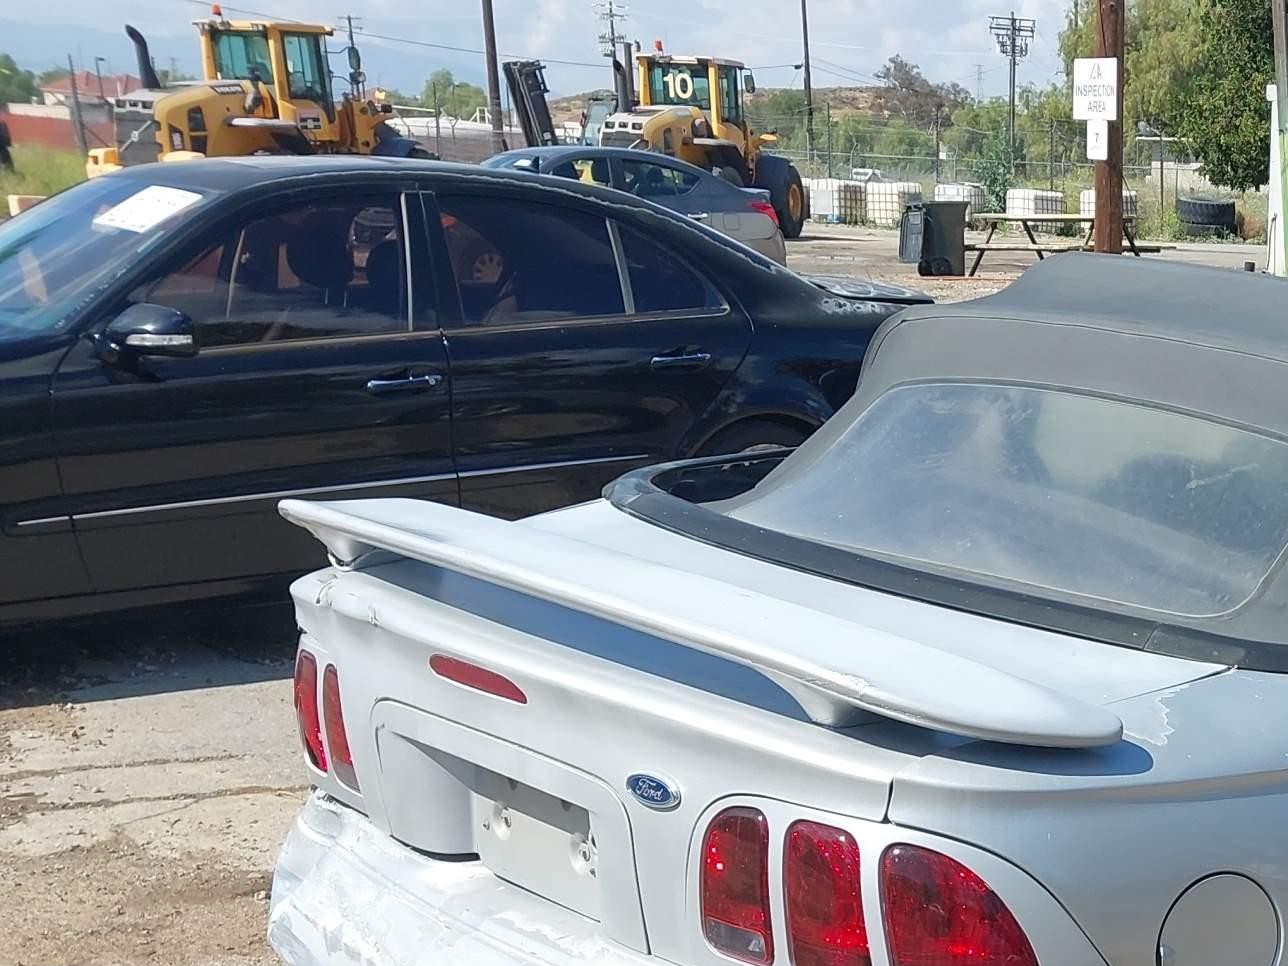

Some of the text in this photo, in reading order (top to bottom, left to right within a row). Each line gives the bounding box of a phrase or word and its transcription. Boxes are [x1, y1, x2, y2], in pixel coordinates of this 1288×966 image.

[663, 73, 693, 99] 10
[1075, 83, 1116, 97] INSPECTION
[1087, 100, 1107, 113] AREA
[1094, 132, 1100, 144] 7
[635, 778, 664, 801] Ford
